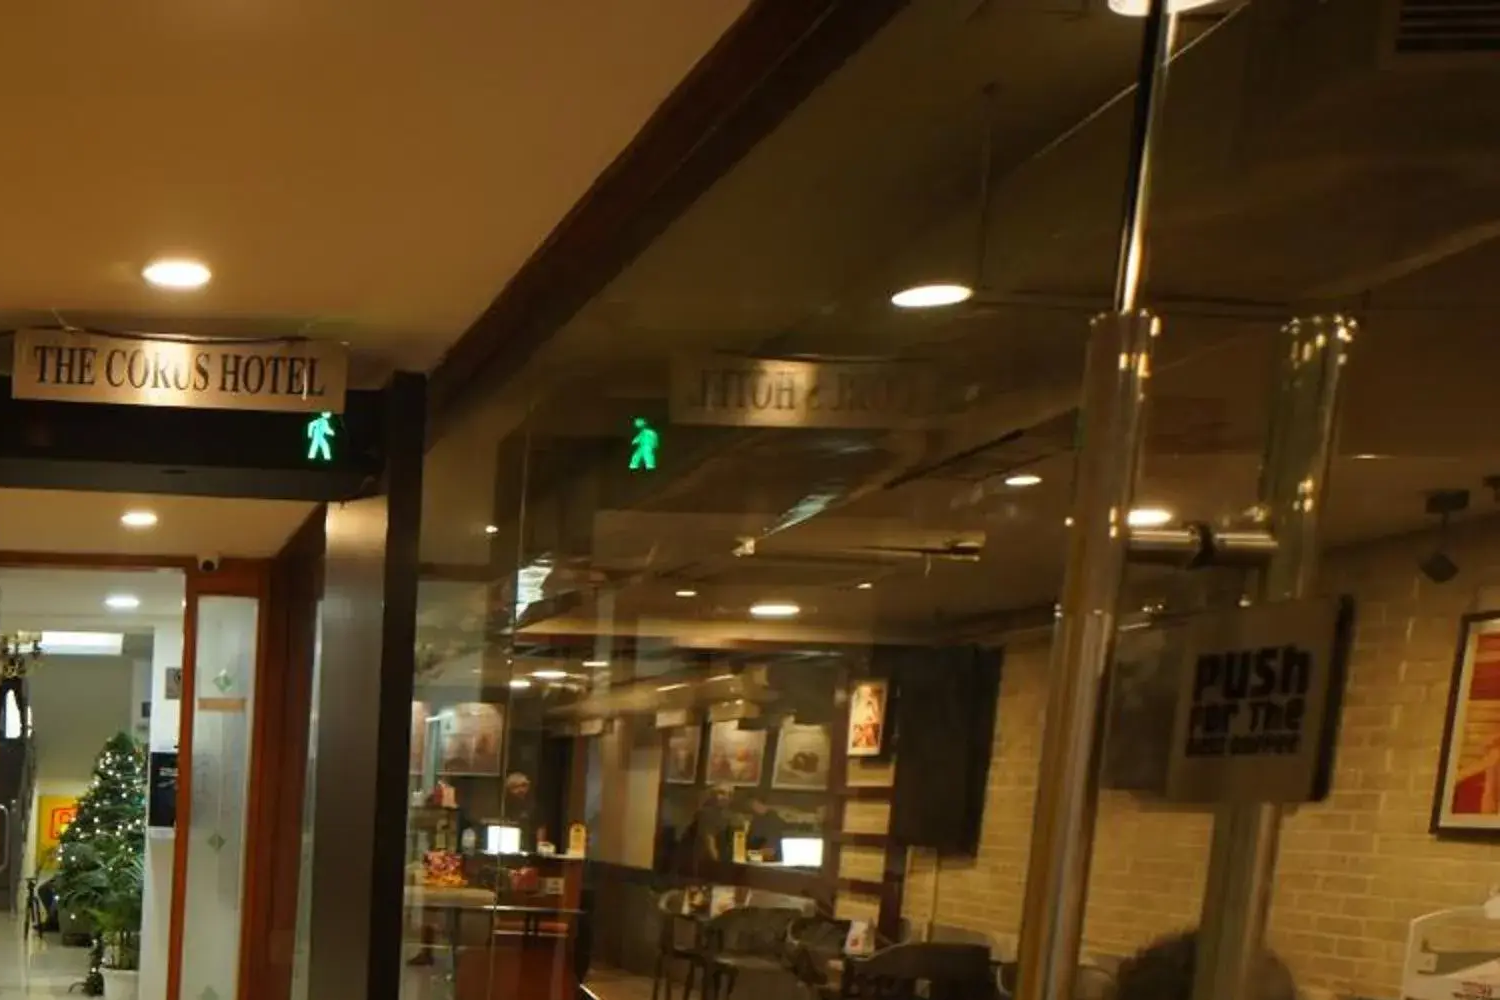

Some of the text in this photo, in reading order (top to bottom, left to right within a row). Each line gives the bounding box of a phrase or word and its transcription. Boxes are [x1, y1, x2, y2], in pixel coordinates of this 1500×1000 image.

[35, 345, 325, 397] THE CORUS HOTEL
